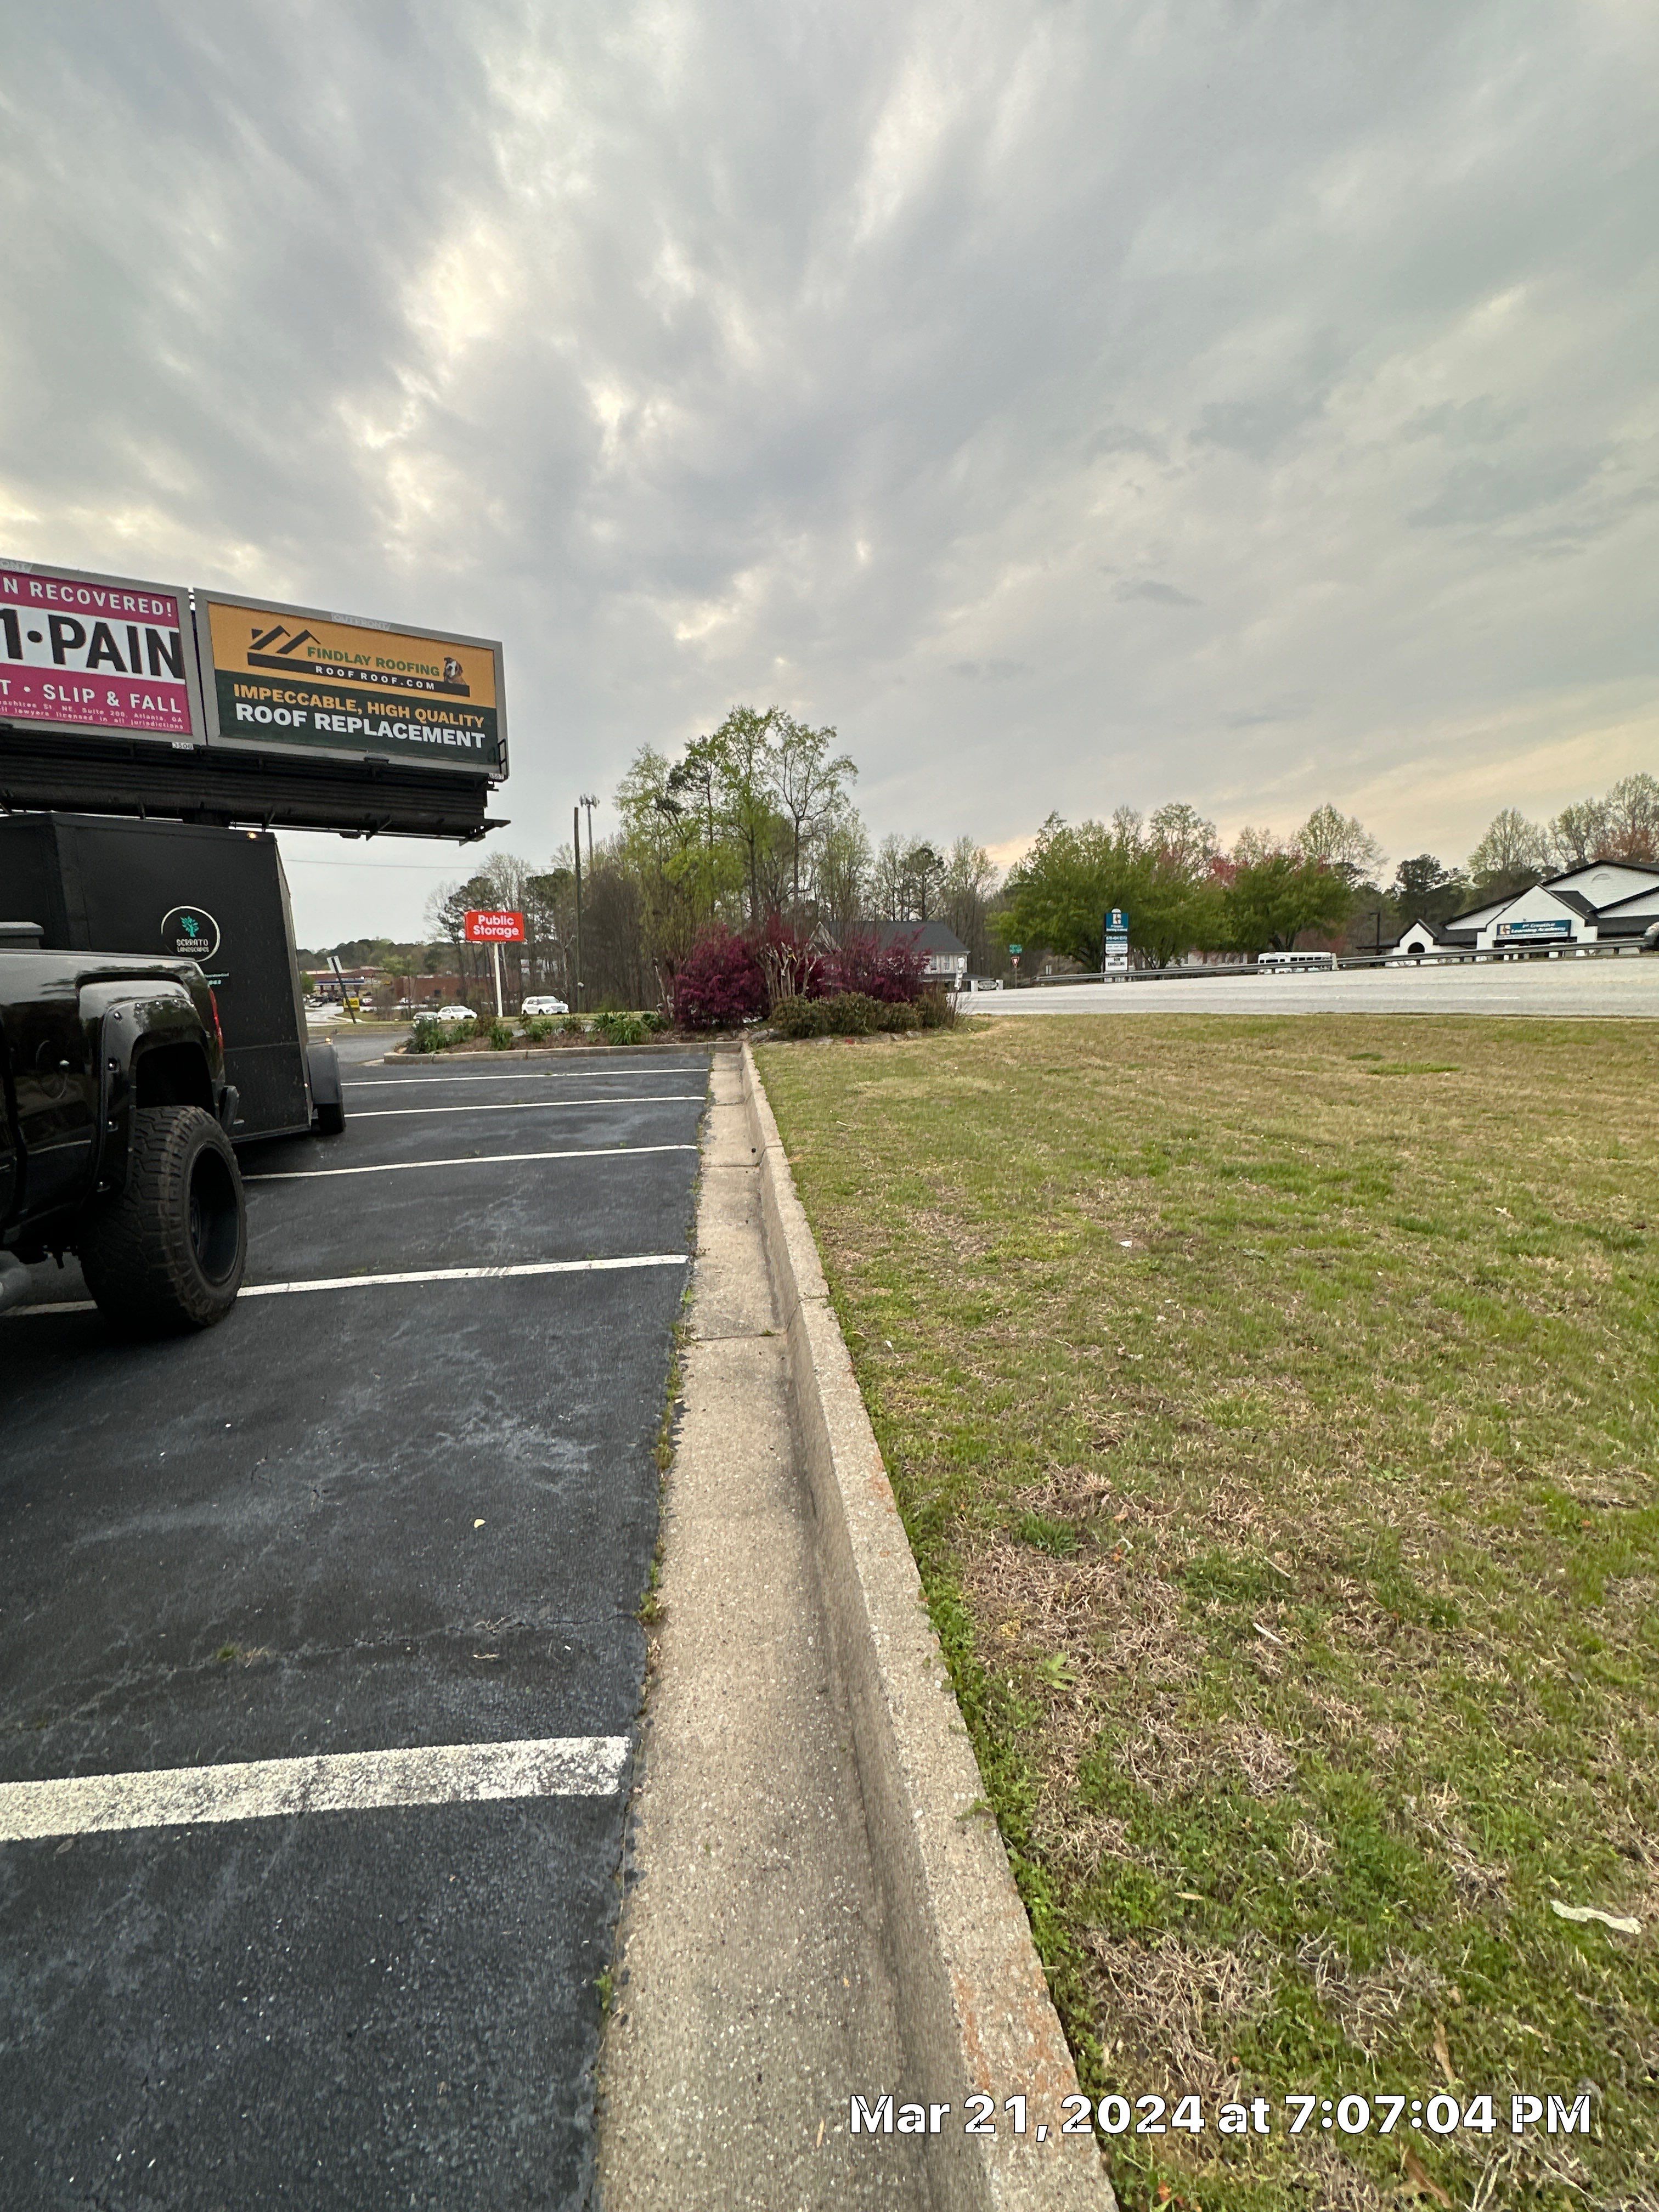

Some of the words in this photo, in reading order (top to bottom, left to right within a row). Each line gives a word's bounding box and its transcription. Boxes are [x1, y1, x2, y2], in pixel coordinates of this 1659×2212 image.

[29, 581, 172, 617] RECOVERED!
[307, 646, 371, 666] FINDLAY
[376, 657, 439, 676] ROOFING
[315, 665, 354, 678] ROOF
[360, 672, 435, 690] ROOF.COM
[43, 684, 95, 703] SLIP
[107, 691, 120, 707] &
[129, 693, 182, 713] FALL
[234, 684, 363, 715] IMPECCABLE,
[368, 701, 410, 719] HIGH
[415, 708, 484, 728] QUALITY
[236, 703, 307, 727] ROOF
[314, 713, 485, 748] REPLACEMENT
[473, 924, 520, 938] Storage
[478, 915, 515, 926] Public
